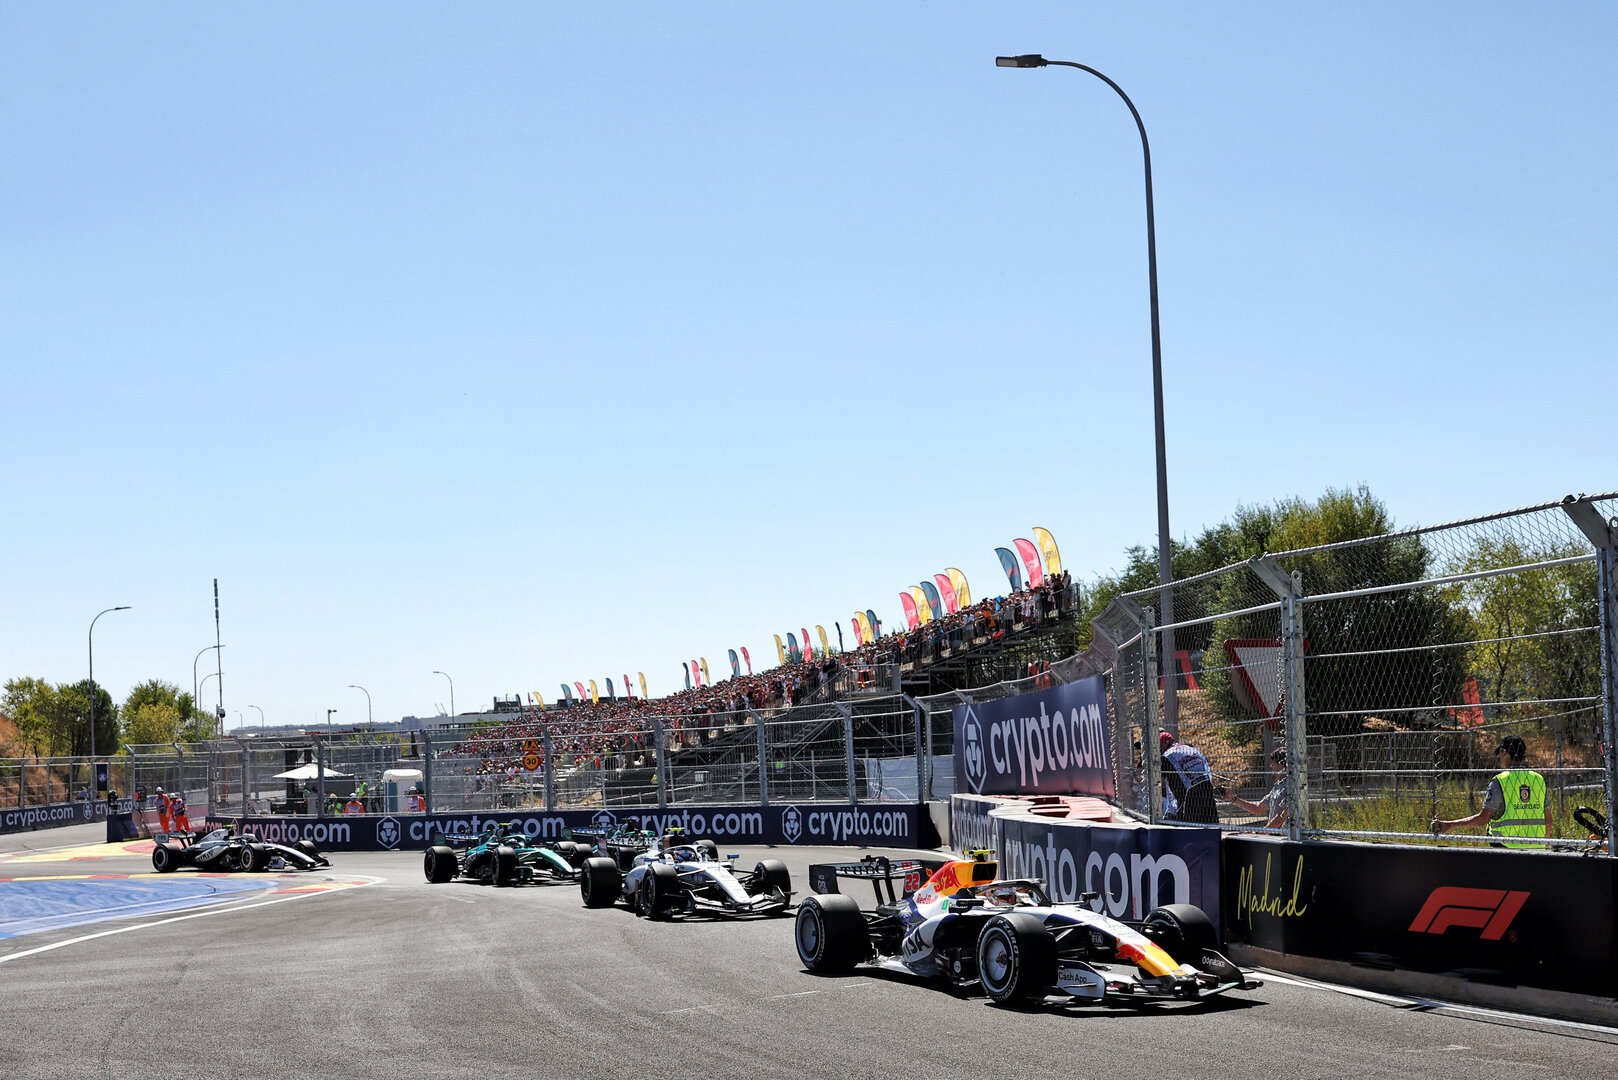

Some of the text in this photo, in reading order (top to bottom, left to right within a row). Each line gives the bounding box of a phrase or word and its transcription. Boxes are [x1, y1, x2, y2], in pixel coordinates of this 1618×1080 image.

[990, 701, 1108, 787] crypto.com
[5, 806, 74, 827] crypto.com
[808, 806, 908, 840] crypto.com
[242, 820, 351, 843] crypto.com
[905, 872, 920, 892] 22
[1237, 852, 1306, 930] Madrid
[1058, 971, 1087, 984] Cash App
